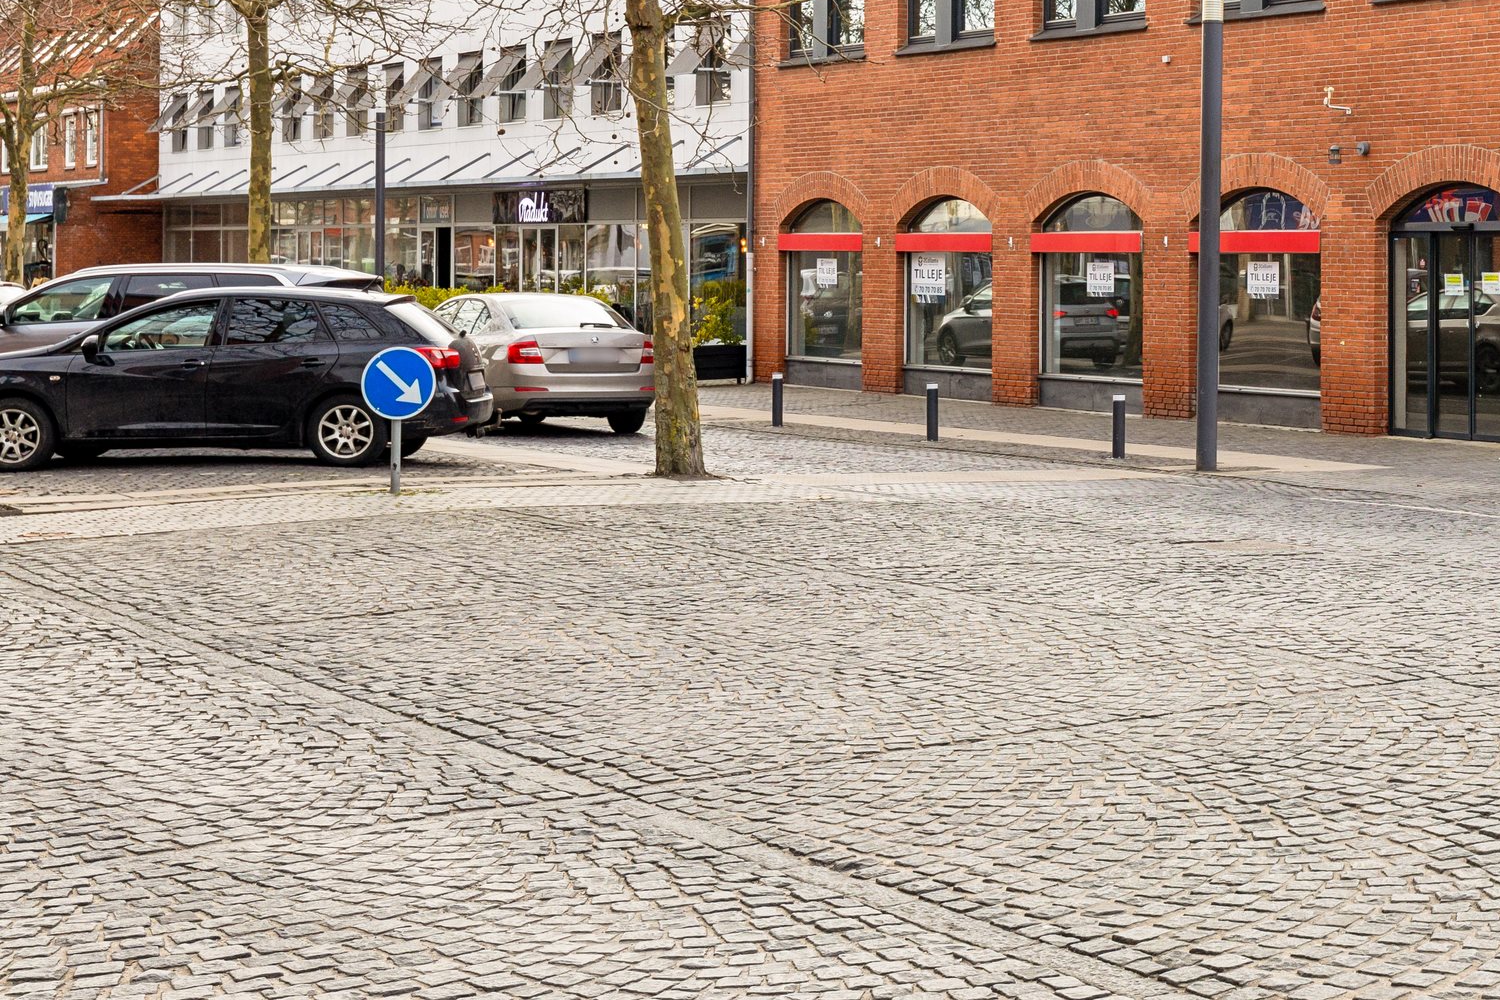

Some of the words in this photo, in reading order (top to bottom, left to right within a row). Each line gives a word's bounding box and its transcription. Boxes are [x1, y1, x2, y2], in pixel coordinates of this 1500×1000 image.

[914, 269, 925, 279] TIL
[928, 269, 942, 281] LEJE
[1089, 273, 1098, 281] TIL
[1100, 273, 1112, 282] LEJE
[1250, 273, 1260, 281] TIL
[1262, 273, 1276, 283] LEJE
